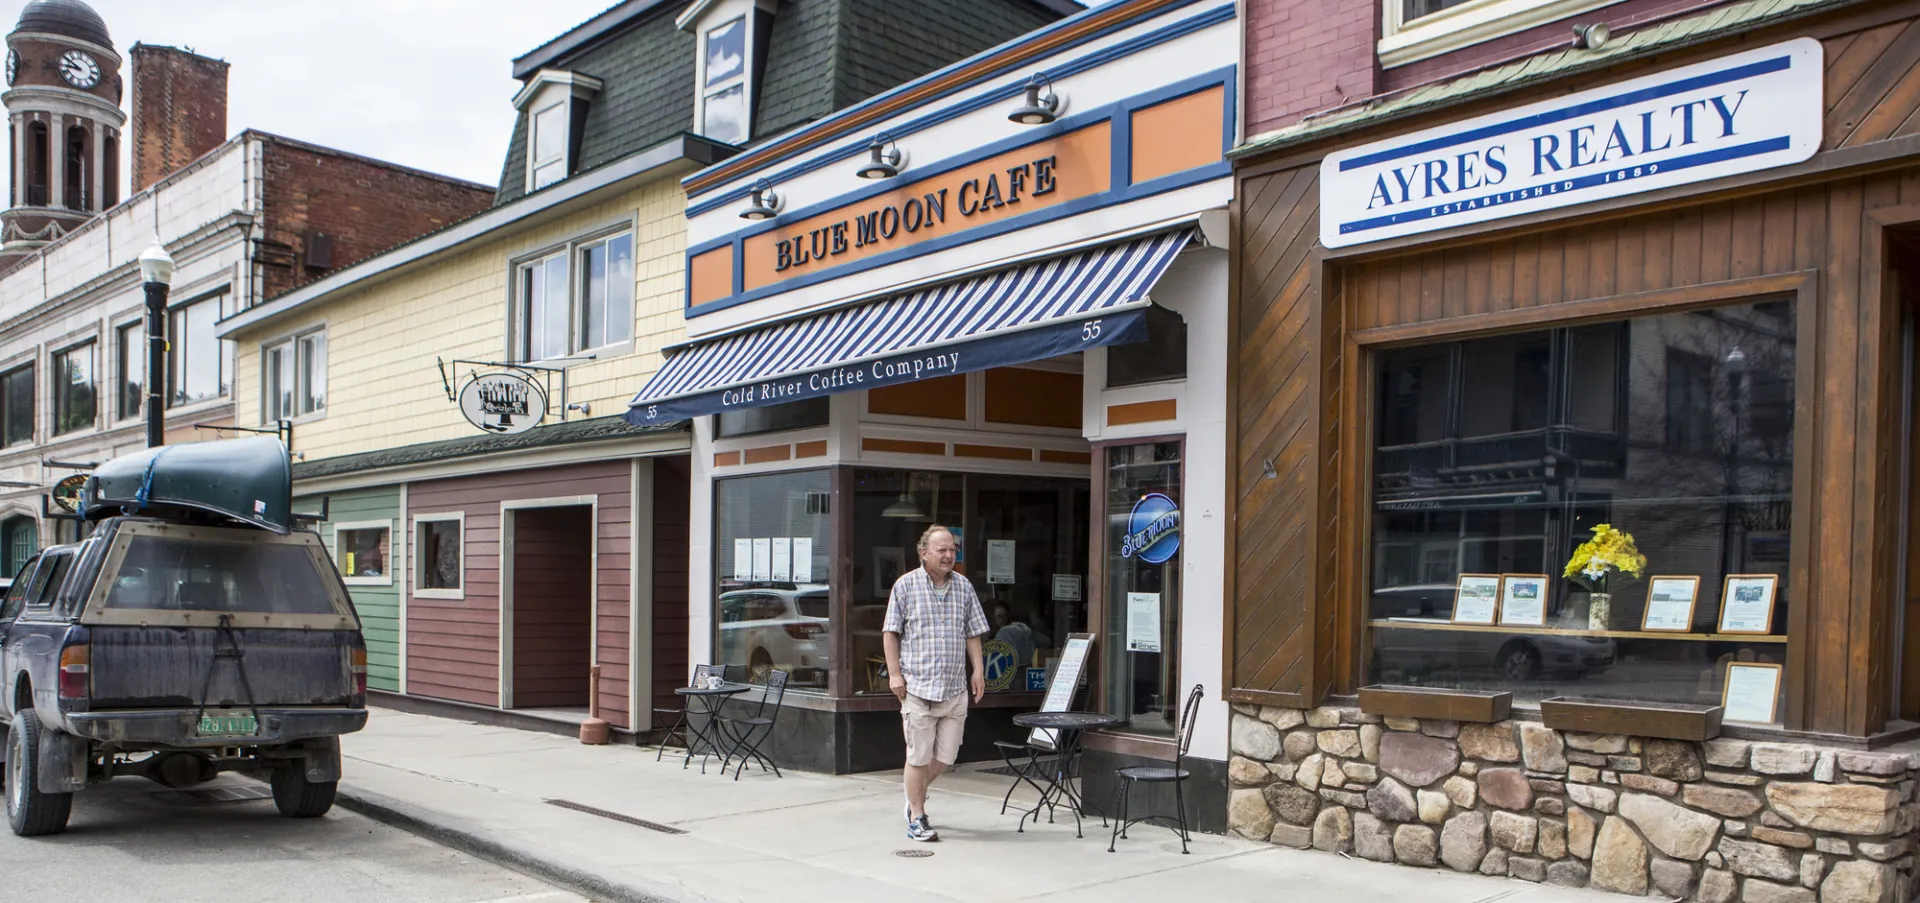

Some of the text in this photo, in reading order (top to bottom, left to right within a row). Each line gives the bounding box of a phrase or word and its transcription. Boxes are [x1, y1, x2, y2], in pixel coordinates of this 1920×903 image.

[1366, 89, 1749, 210] AYRES REALTY
[775, 155, 1056, 272] BLUE MOON CAFE
[1431, 164, 1659, 216] ESTABLISHED 1889
[1081, 319, 1102, 341] 55
[722, 352, 959, 406] Cold River Coffee Company
[646, 405, 657, 419] 55
[985, 652, 1003, 680] K
